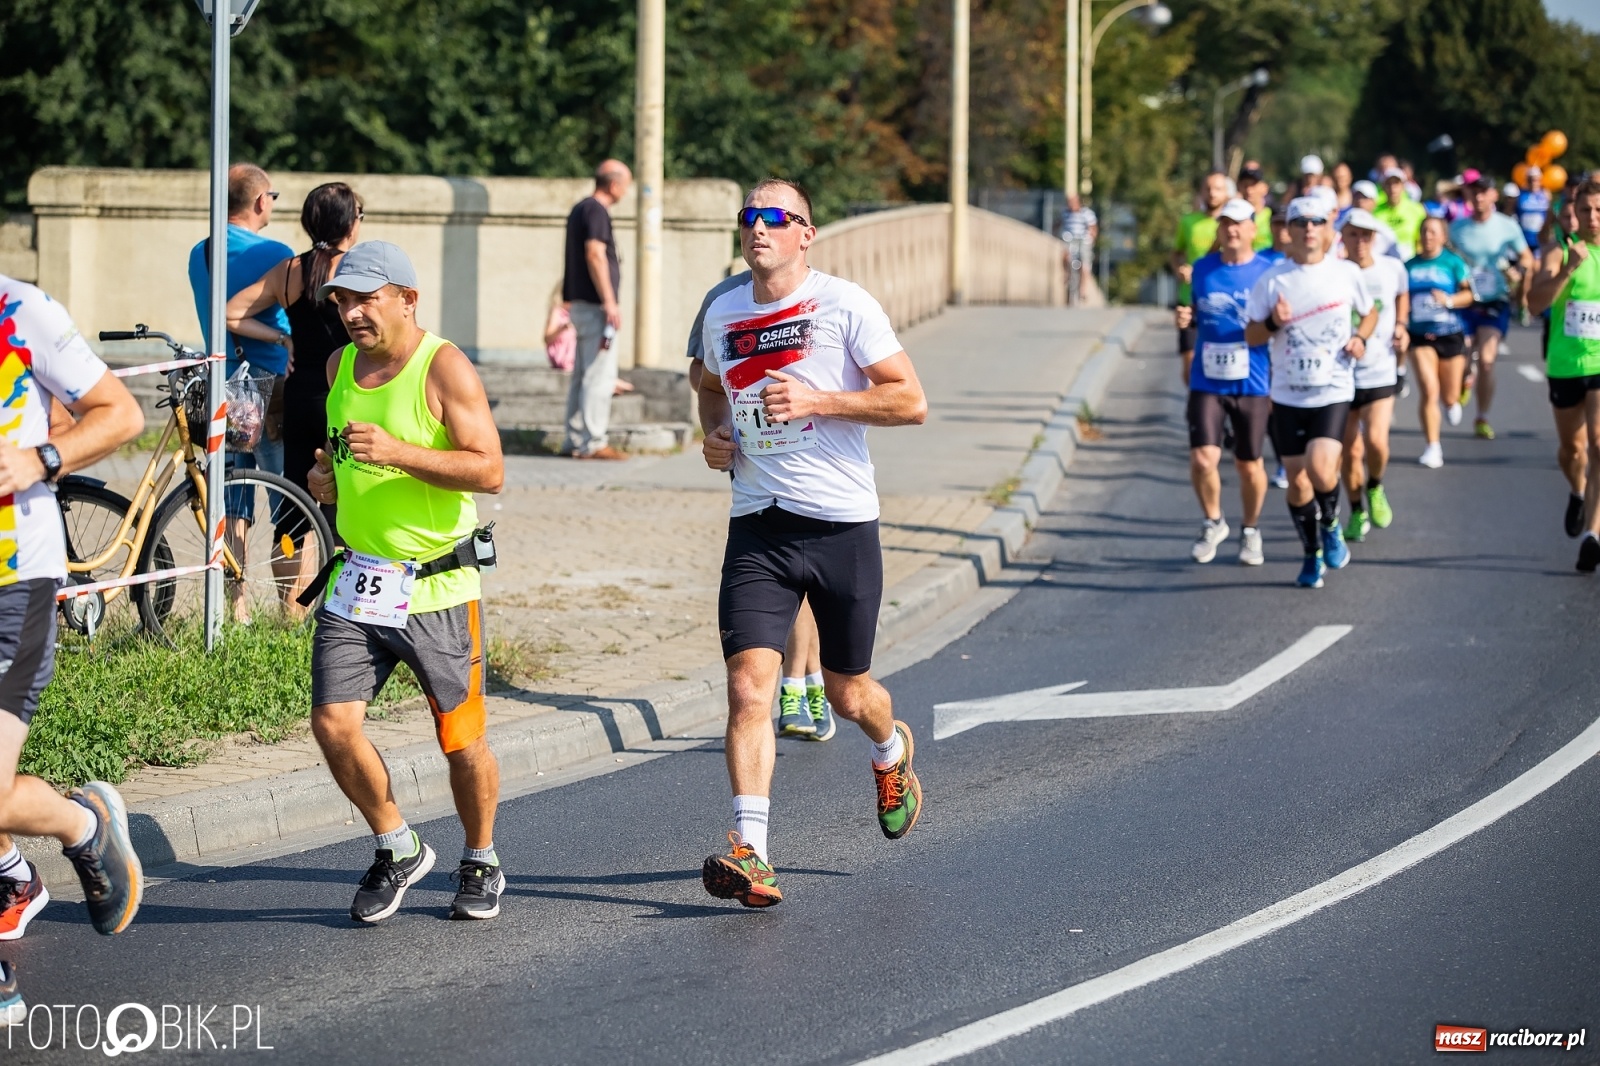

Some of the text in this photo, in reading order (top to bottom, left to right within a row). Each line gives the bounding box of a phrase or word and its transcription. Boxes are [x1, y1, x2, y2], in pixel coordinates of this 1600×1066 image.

[760, 325, 801, 343] OSIEK
[758, 338, 801, 350] TRIATHLON
[355, 572, 383, 596] 85
